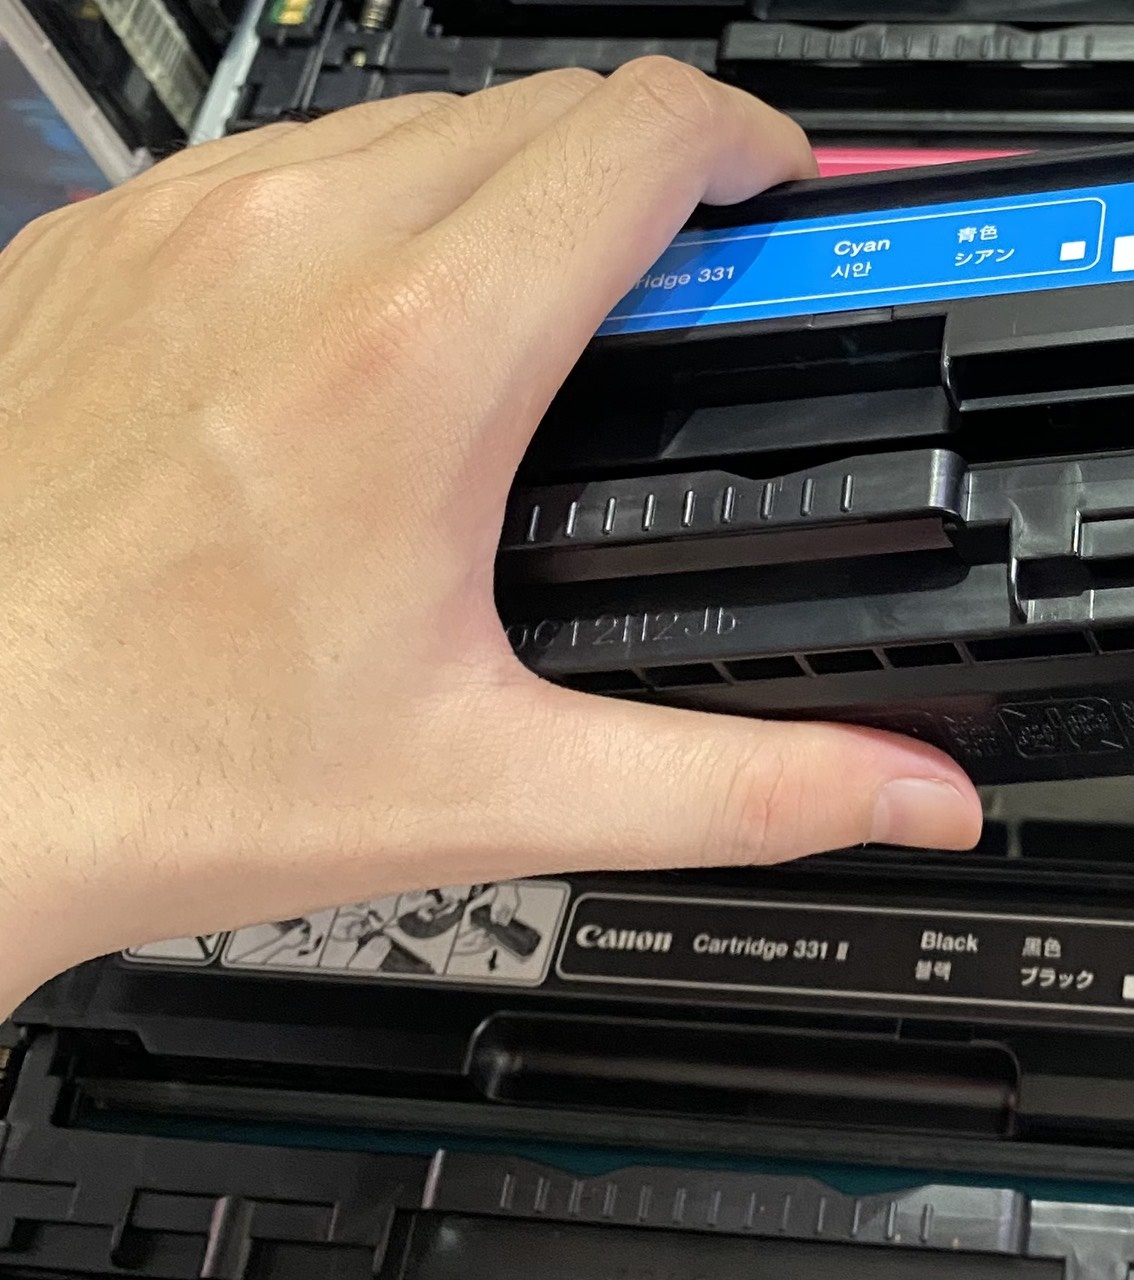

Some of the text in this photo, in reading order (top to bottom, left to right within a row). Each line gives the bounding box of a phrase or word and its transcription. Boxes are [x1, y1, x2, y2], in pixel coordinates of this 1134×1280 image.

[956, 225, 999, 245] 青色
[833, 238, 891, 257] Cyan
[954, 247, 1016, 267] シアン
[697, 265, 735, 282] 331
[830, 261, 872, 280] 시안
[575, 924, 673, 951] Canon
[693, 933, 789, 961] Cartridge
[793, 938, 829, 960] 331
[920, 930, 980, 953] Black
[1020, 966, 1095, 990] ブラック
